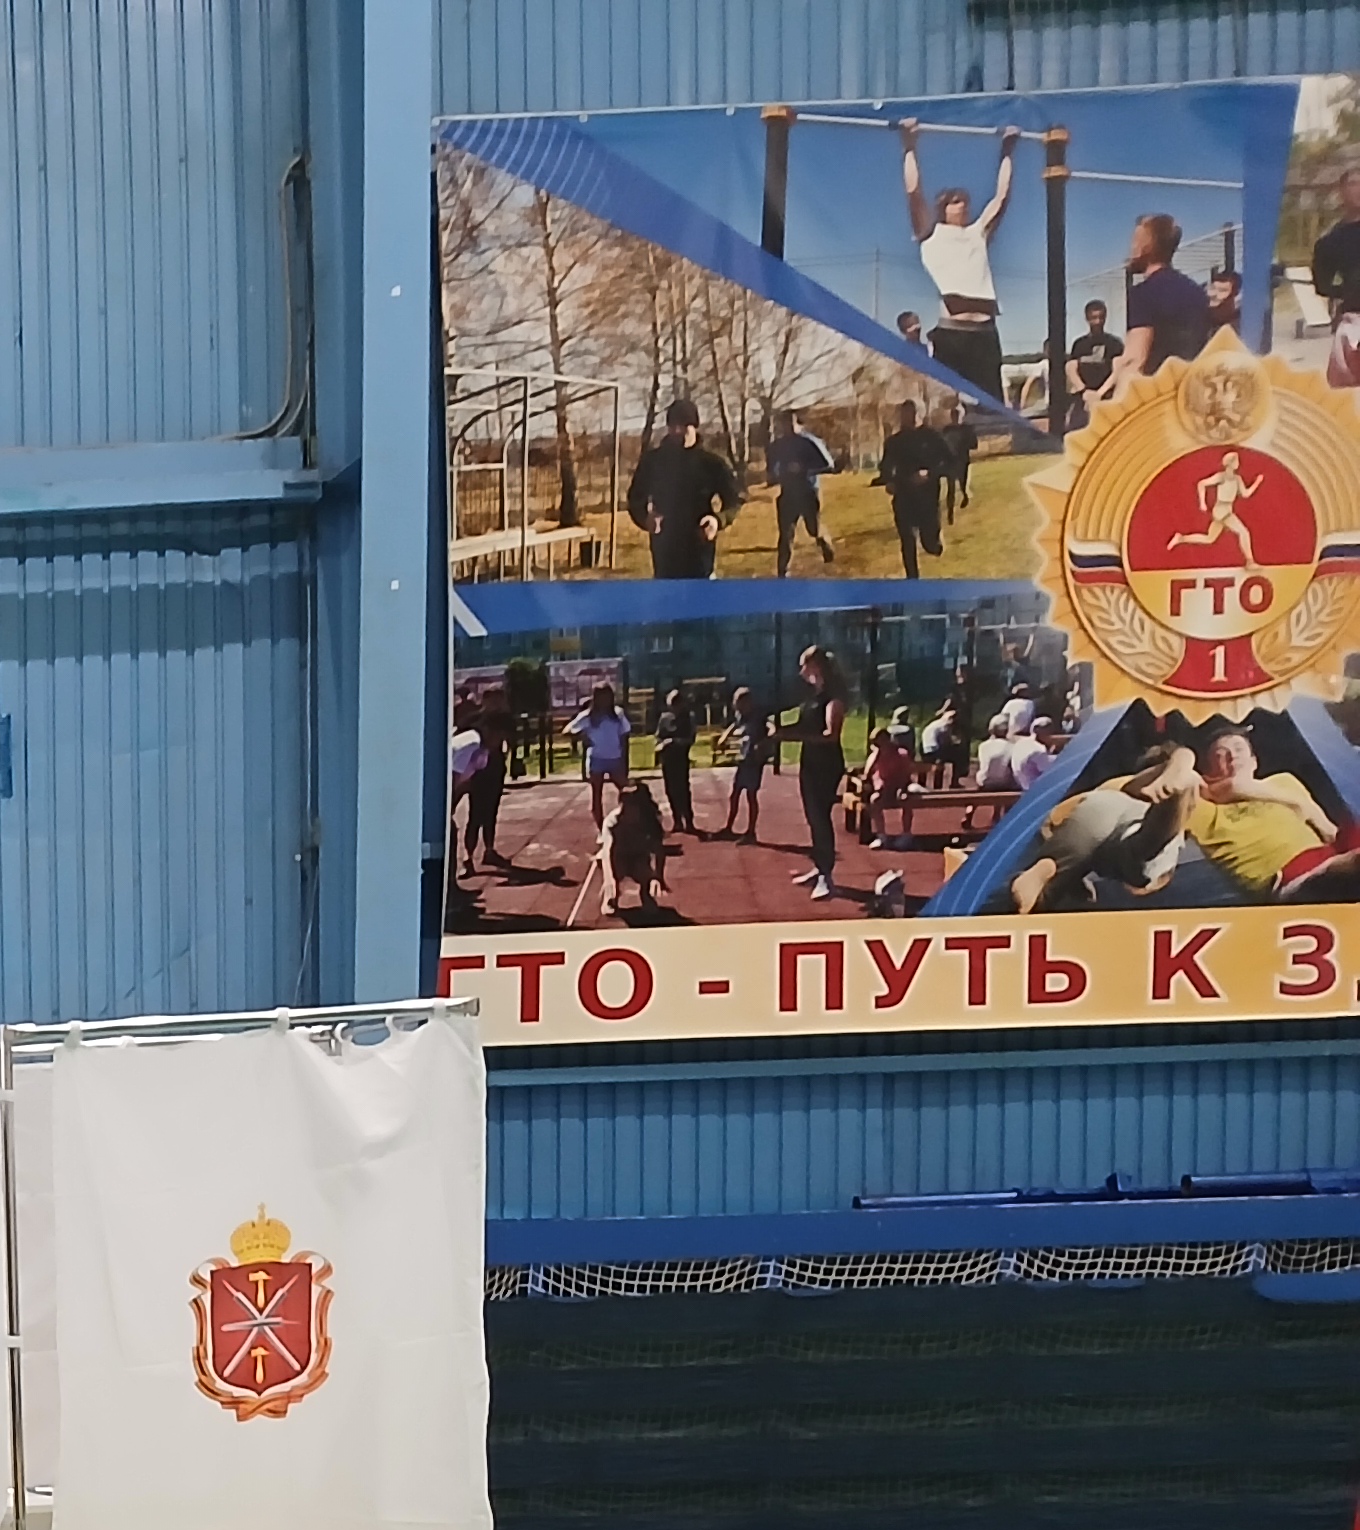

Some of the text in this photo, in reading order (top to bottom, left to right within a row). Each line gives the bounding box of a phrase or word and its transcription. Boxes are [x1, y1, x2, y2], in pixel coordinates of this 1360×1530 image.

[1169, 575, 1274, 617] ГТО
[1208, 644, 1229, 682] 1
[436, 947, 655, 1023] ГТО
[778, 933, 1088, 1013] ПУТЬ
[1151, 927, 1222, 1000] К
[1279, 923, 1360, 1003] З
